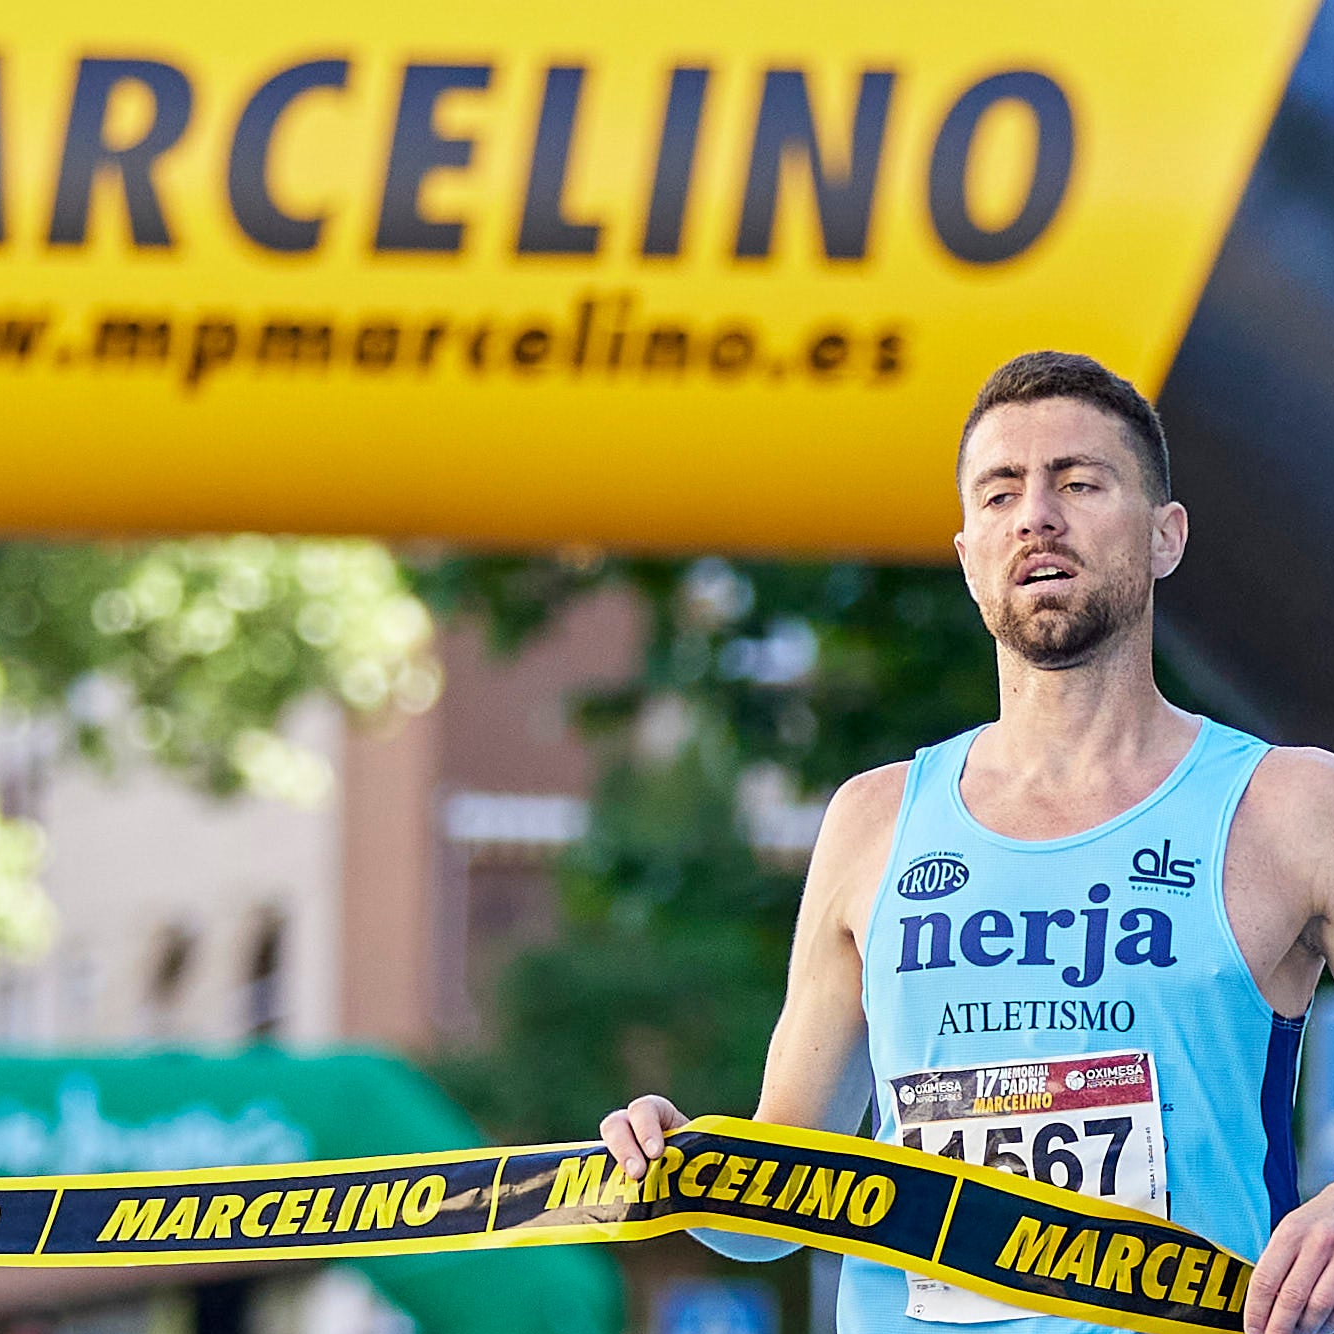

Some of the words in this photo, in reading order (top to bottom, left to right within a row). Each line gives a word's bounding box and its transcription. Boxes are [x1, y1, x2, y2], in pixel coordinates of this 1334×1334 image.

[900, 861, 966, 894] TROPS
[1128, 838, 1196, 889] als
[896, 883, 1177, 988] nerja
[937, 999, 1135, 1036] ATLETISMO
[976, 1068, 1000, 1098] 17
[999, 1064, 1050, 1080] MEMORIAL
[1000, 1076, 1047, 1096] PADRE
[1085, 1064, 1145, 1080] OXIMESA
[915, 1081, 962, 1094] OXIMESA
[972, 1091, 1053, 1114] MARCELINO
[98, 1176, 447, 1242] MARCELINO
[544, 1145, 896, 1227] MARCELINO
[995, 1215, 1253, 1313] MARCELI
